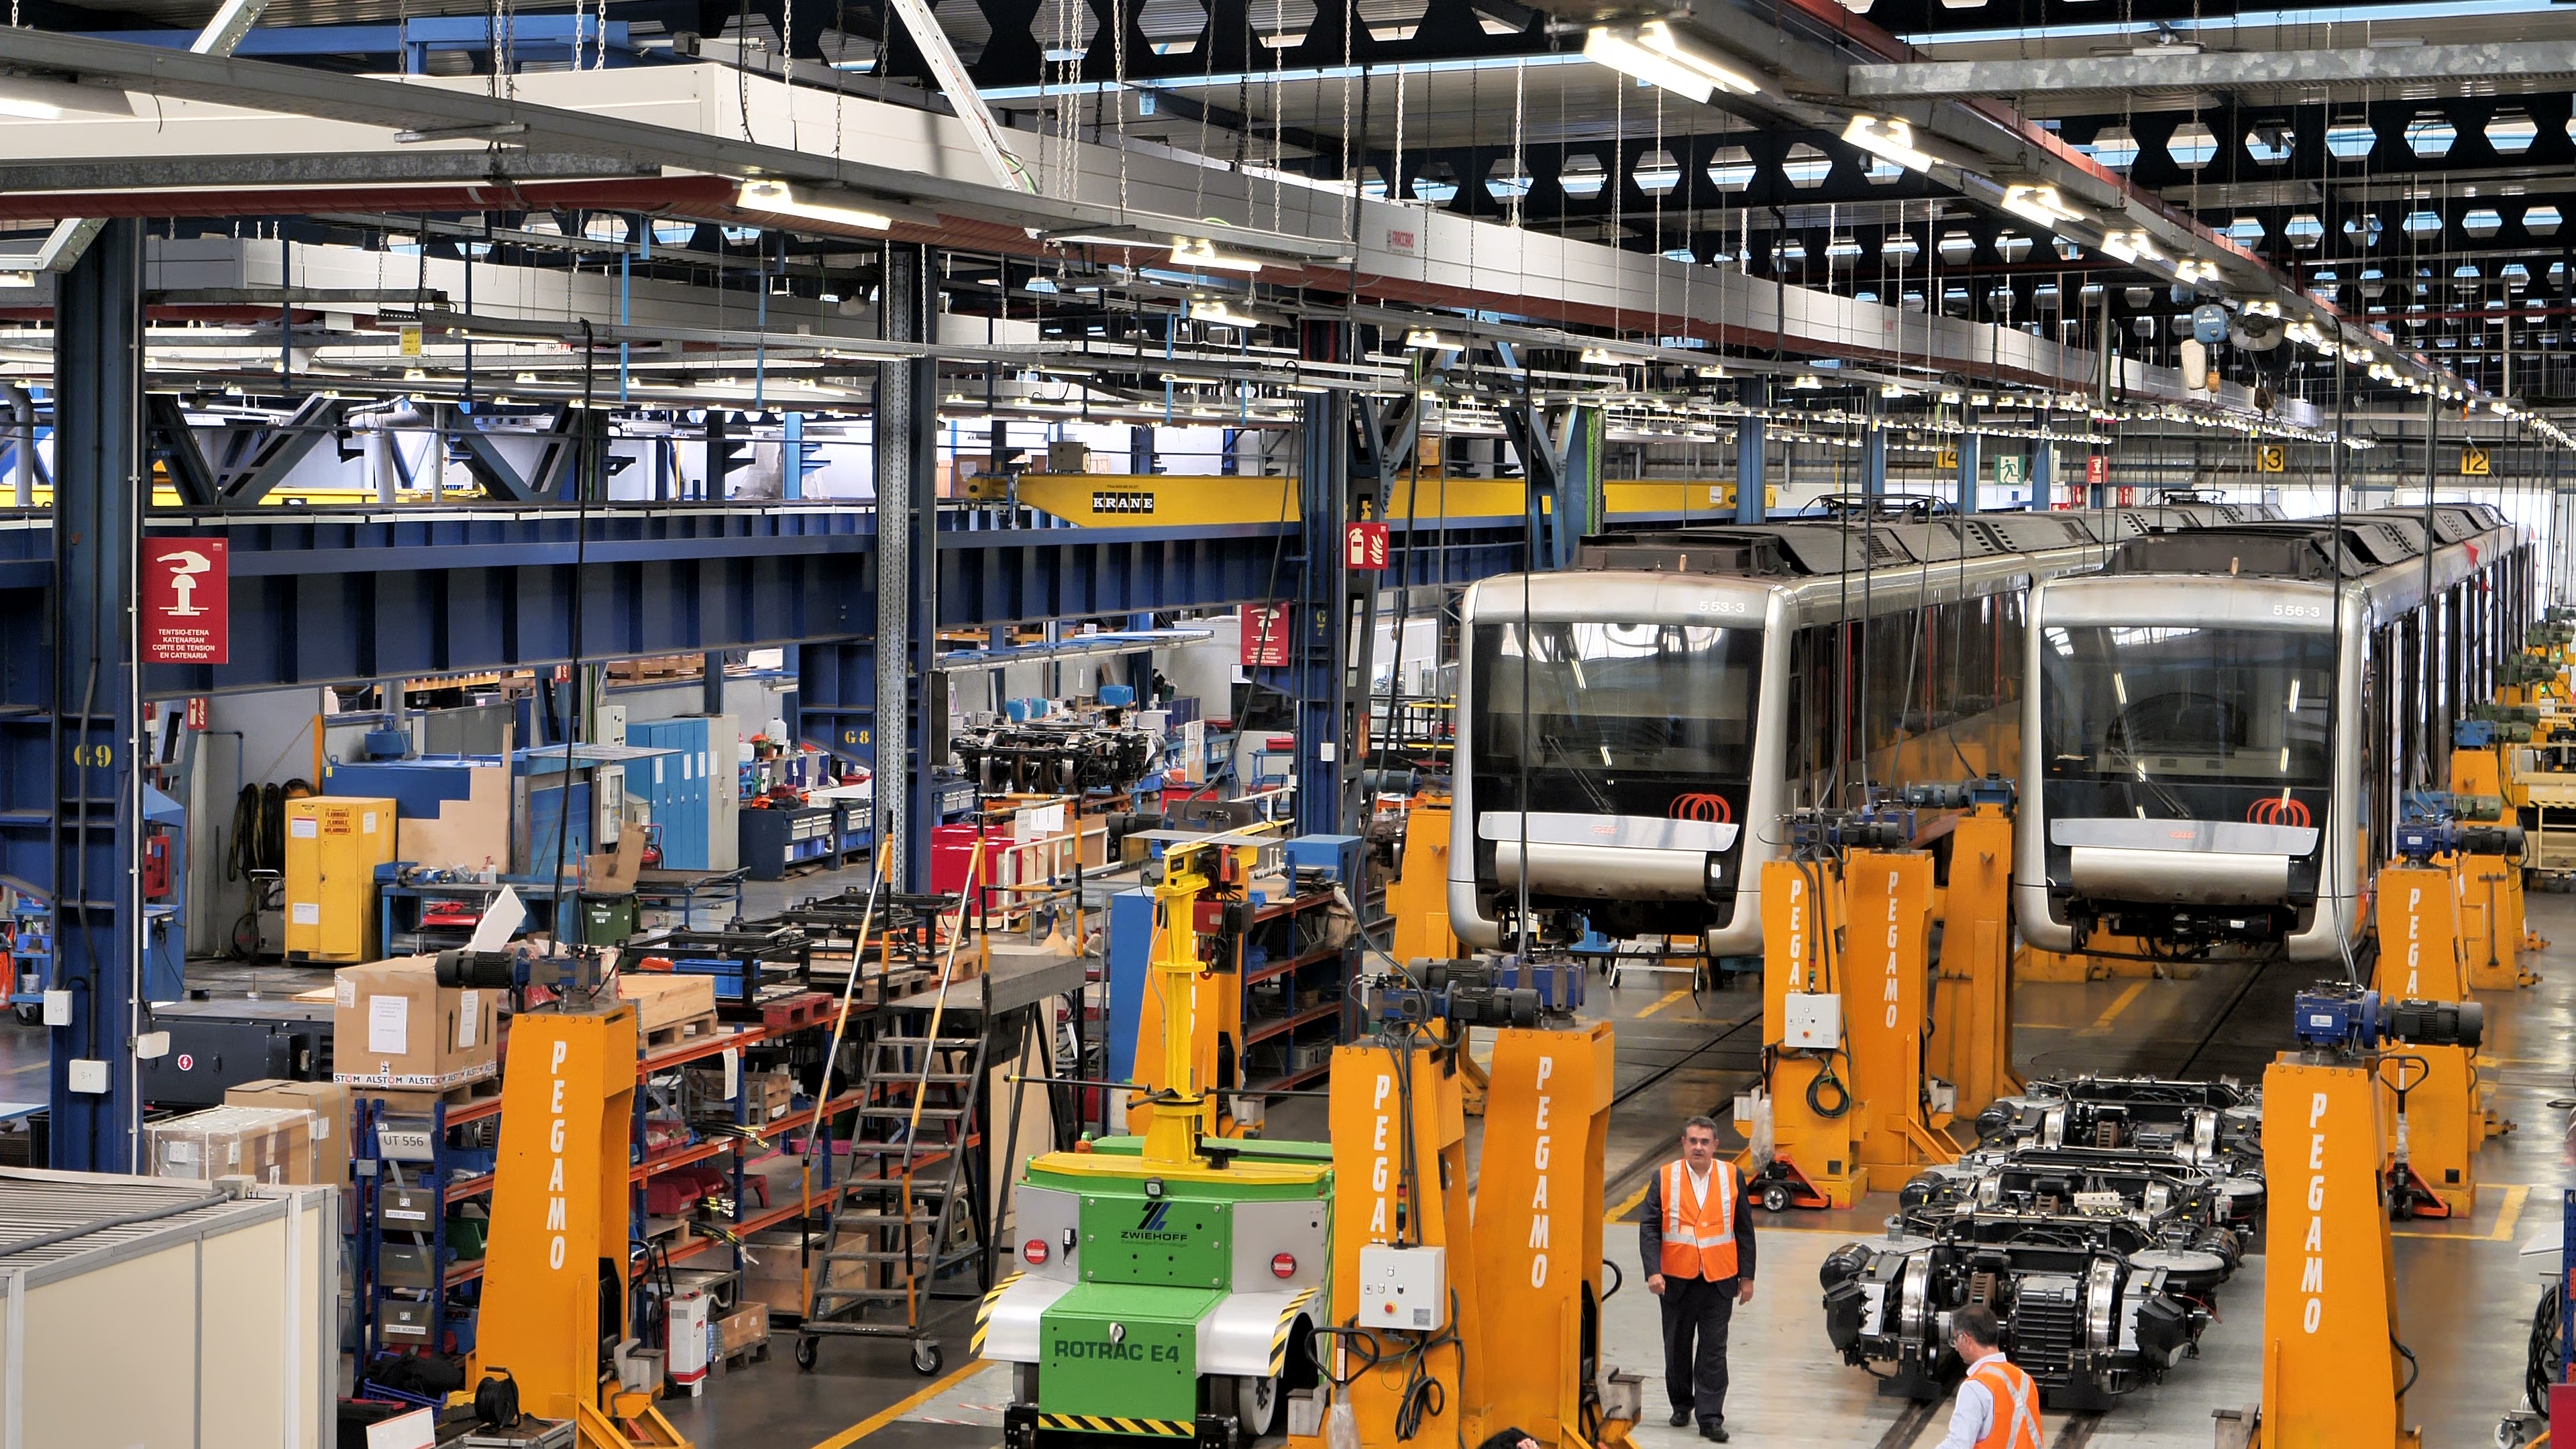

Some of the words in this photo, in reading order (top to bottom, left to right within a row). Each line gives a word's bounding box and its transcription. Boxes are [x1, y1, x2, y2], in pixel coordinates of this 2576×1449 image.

[2464, 451, 2487, 471] 12
[1093, 498, 1153, 508] KRANE
[1788, 879, 1803, 994] PEGA
[1884, 871, 1898, 1028] PEGAMO
[335, 1075, 360, 1083] STOM
[366, 1076, 402, 1084] ALSTOM
[384, 1136, 399, 1146] UT
[402, 1136, 424, 1146] 556
[546, 1040, 567, 1270] PEGAMO
[1370, 1075, 1391, 1243] PEGA
[1529, 1056, 1552, 1289] PEGAMO
[1120, 1231, 1188, 1241] ZWIEHOFF
[2301, 1093, 2328, 1334] PEGAMO
[1055, 1340, 1143, 1361] ROTRAC
[1150, 1345, 1179, 1363] E4
